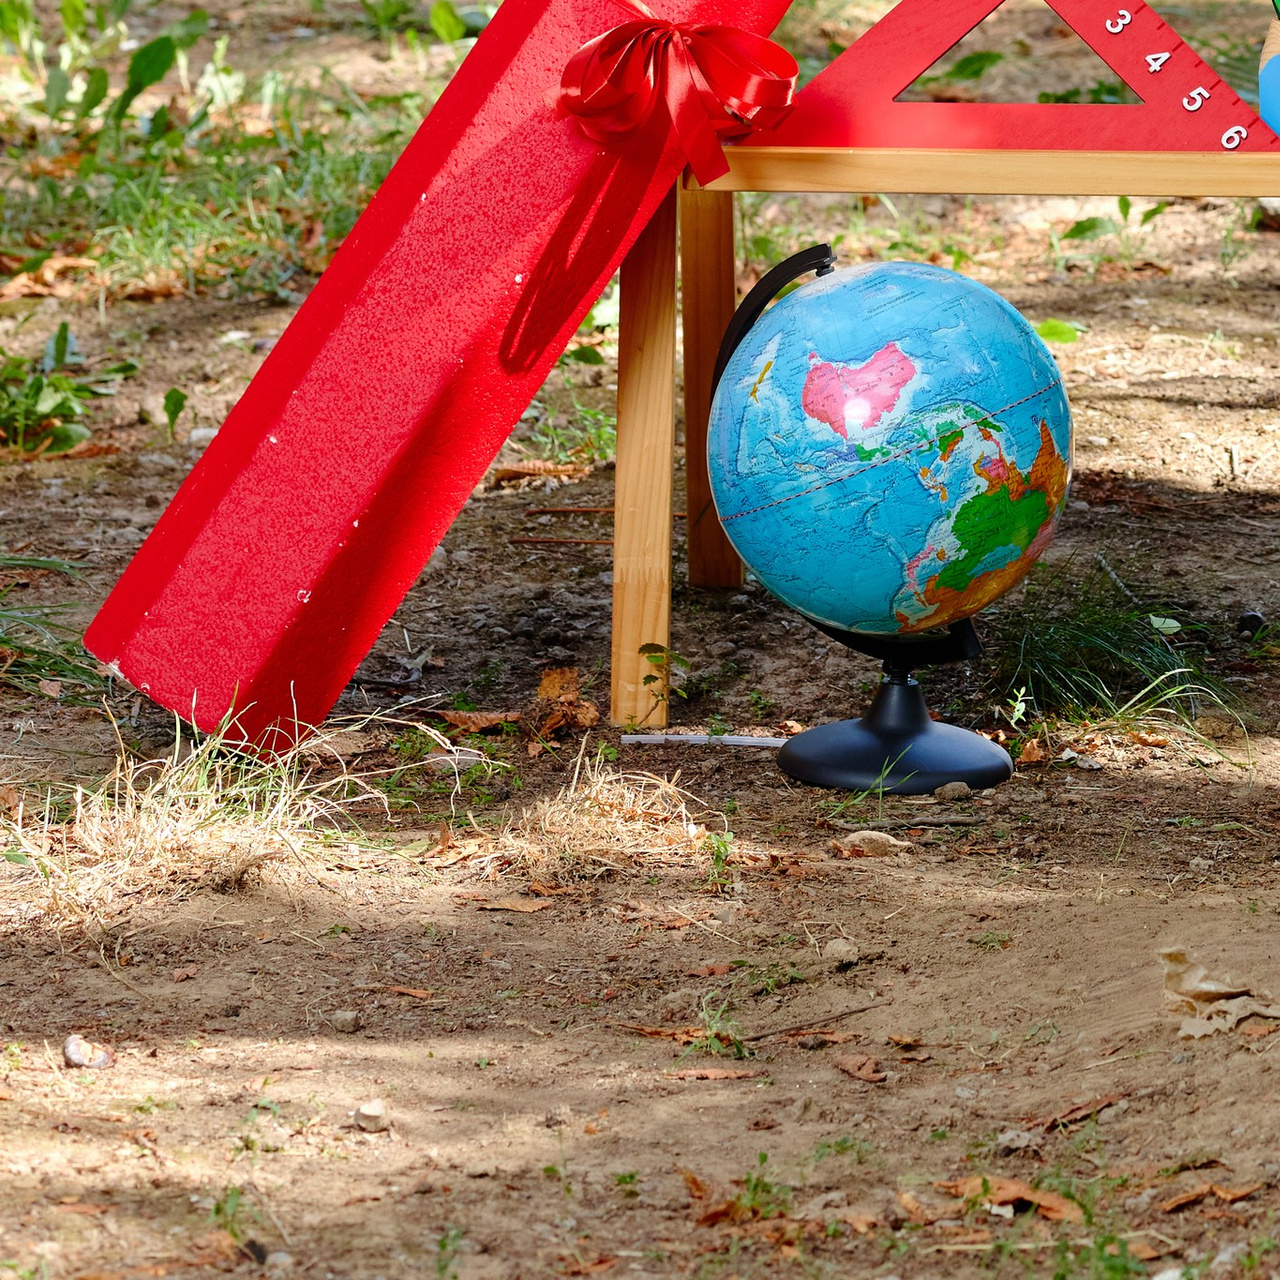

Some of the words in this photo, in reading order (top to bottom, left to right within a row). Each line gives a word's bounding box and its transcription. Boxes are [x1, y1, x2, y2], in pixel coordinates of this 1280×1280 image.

[1105, 9, 1132, 34] 3
[1144, 51, 1172, 74] 4
[1182, 86, 1210, 112] 5
[1220, 125, 1249, 150] 6
